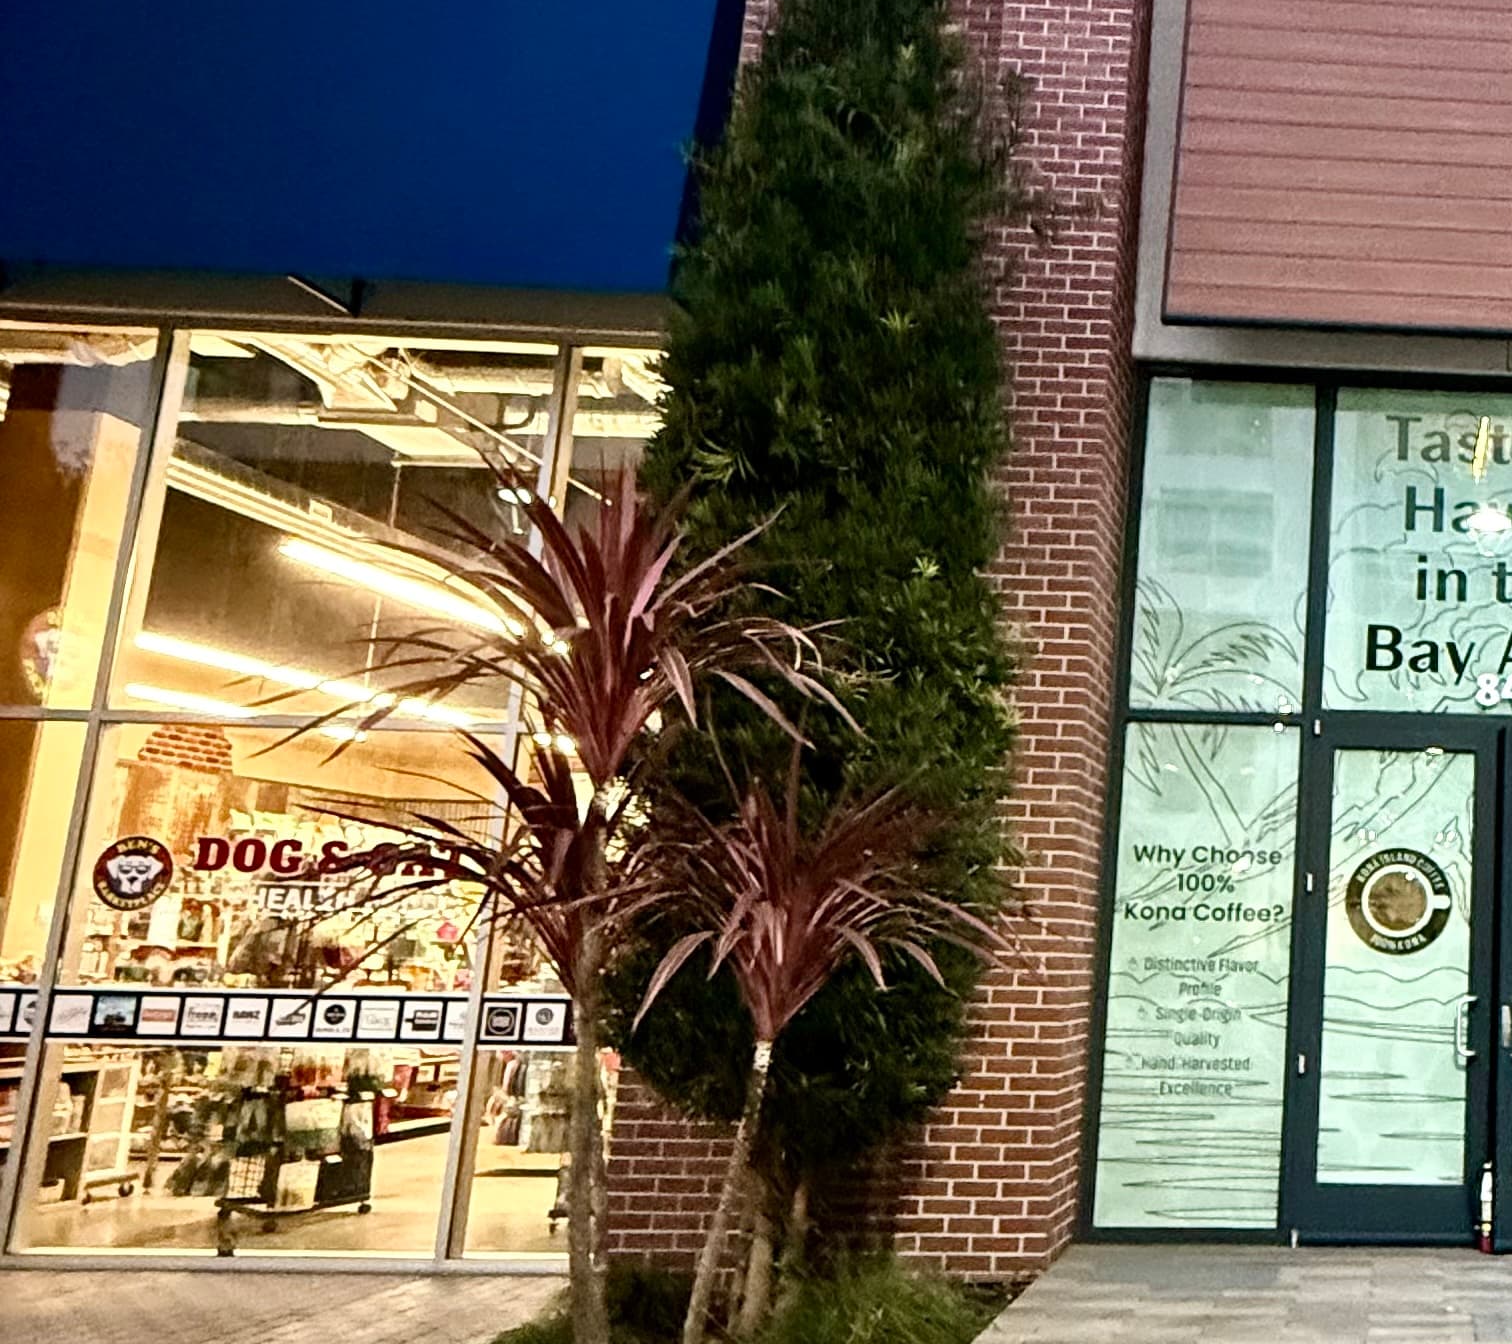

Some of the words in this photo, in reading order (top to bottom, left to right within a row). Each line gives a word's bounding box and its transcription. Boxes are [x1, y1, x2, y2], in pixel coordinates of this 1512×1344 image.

[1416, 555, 1468, 602] in
[1365, 623, 1476, 686] Bay
[193, 836, 303, 874] DOG
[1133, 844, 1186, 869] Why
[1177, 873, 1236, 894] 100%
[1124, 902, 1187, 921] Kona
[1192, 902, 1285, 923] Coffee?
[1143, 956, 1216, 972] Distinctive
[1218, 958, 1259, 972] Flavor
[1178, 981, 1223, 996] Profile
[1173, 1031, 1222, 1049] Quality
[1159, 1081, 1233, 1097] Excellence
